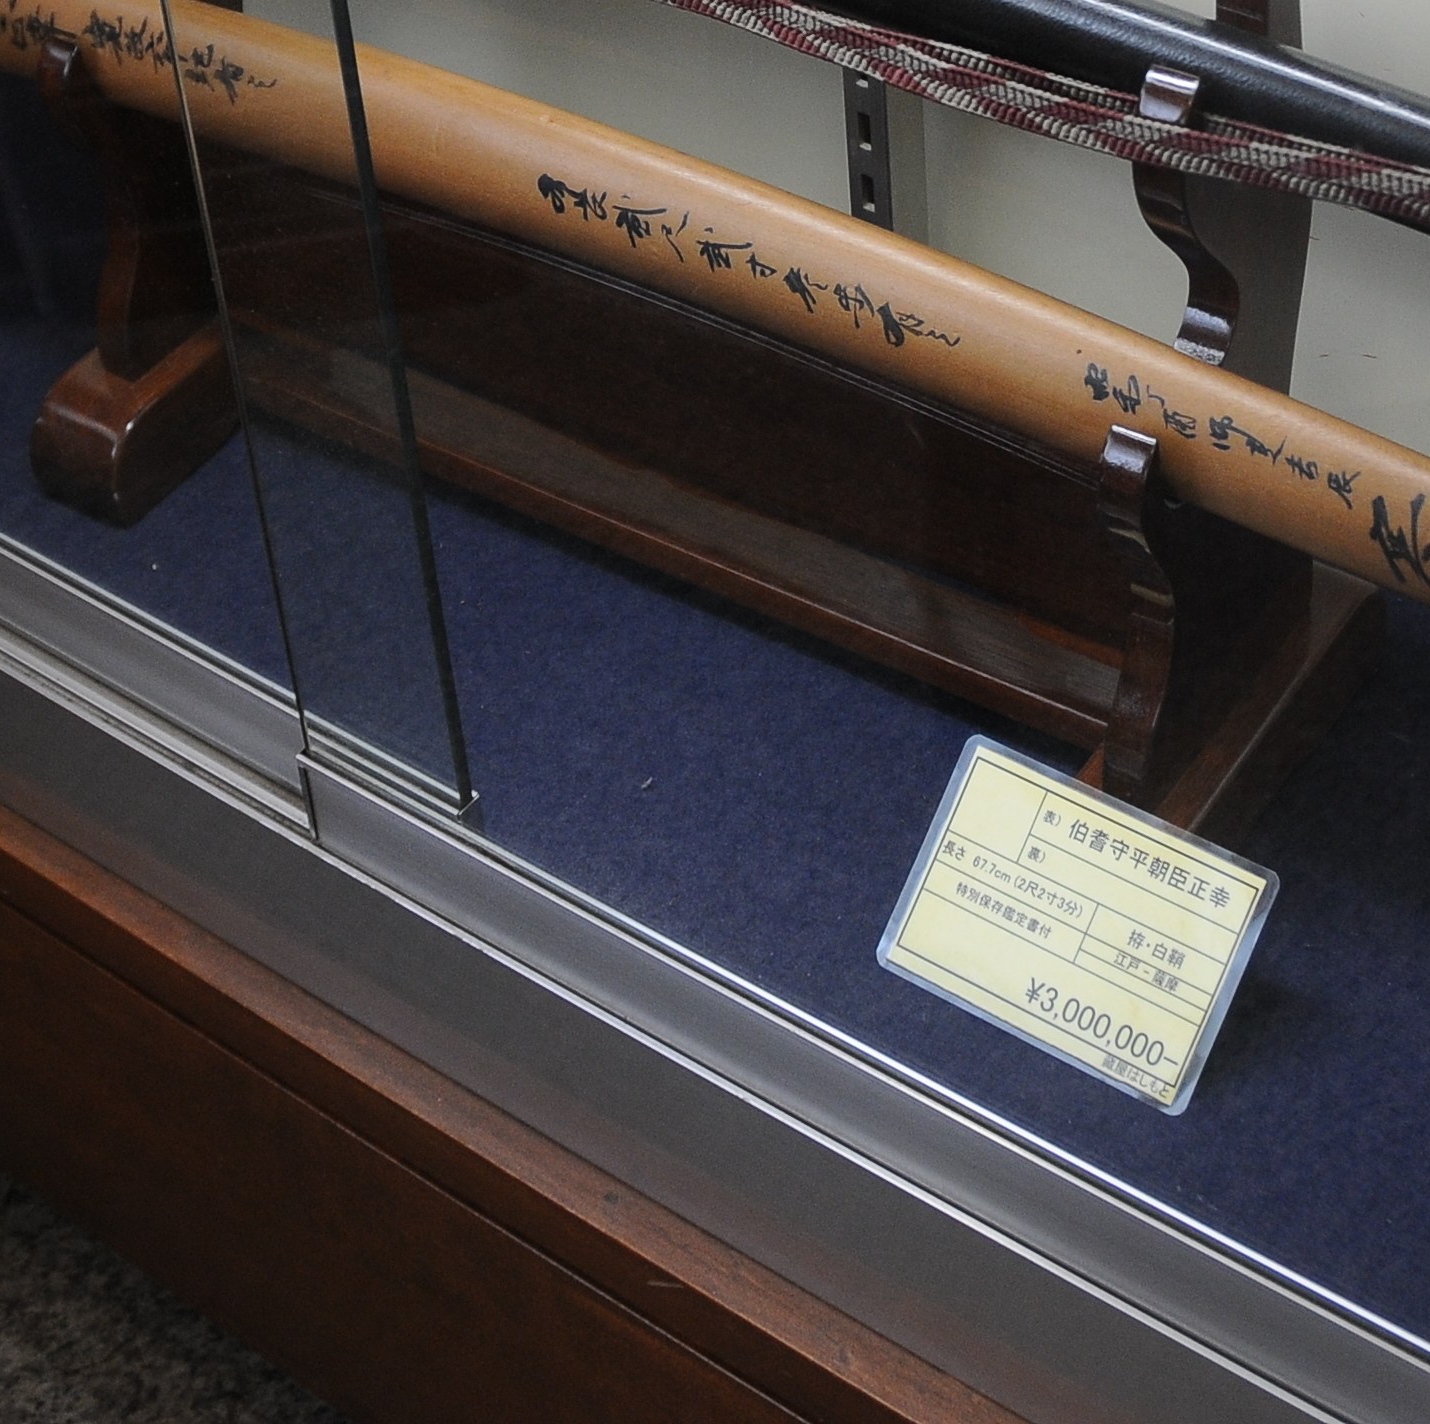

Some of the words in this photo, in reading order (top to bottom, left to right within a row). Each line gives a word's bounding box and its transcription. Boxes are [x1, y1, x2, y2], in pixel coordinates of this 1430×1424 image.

[972, 854, 1011, 883] 67.7cm
[1070, 819, 1231, 909] 伯耆守平朝臣正幸
[956, 882, 1052, 939] 特別保存鑑定書付
